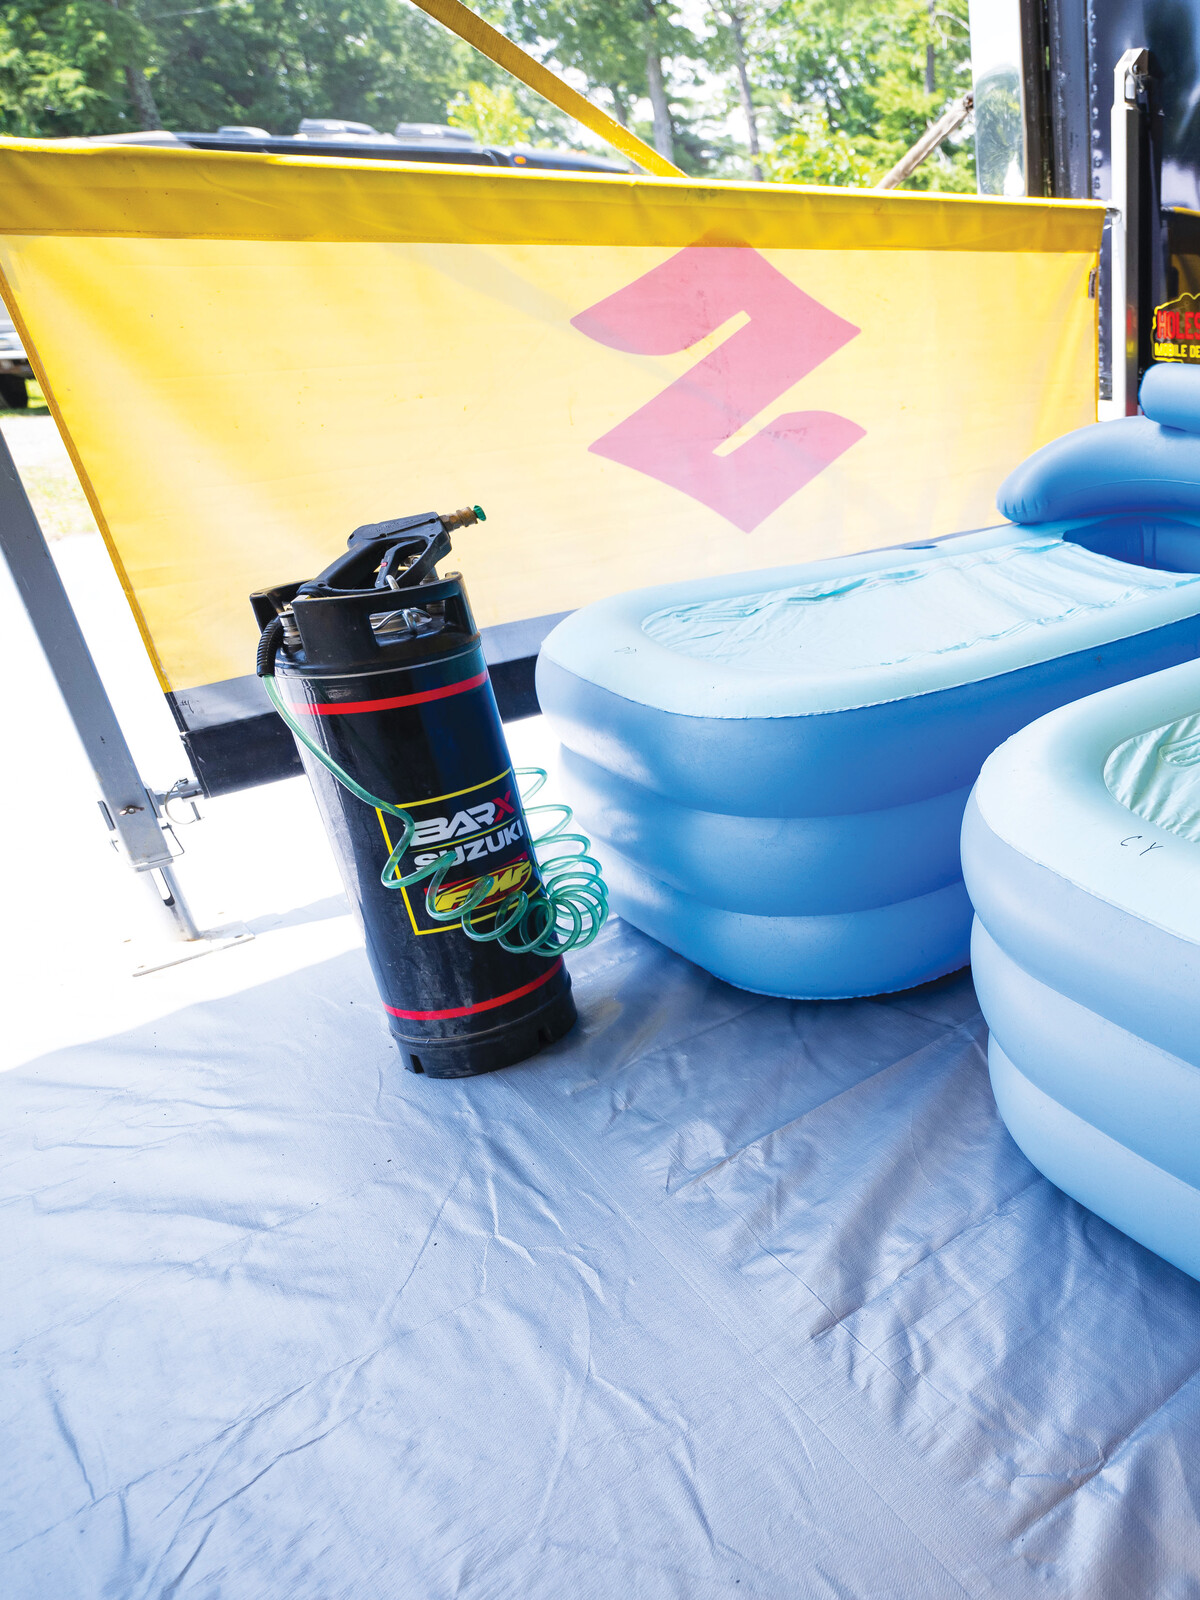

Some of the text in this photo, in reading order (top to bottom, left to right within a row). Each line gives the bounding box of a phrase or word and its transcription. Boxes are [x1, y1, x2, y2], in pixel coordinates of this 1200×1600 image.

[1155, 342, 1187, 358] MOBILE
[410, 790, 515, 847] BARX
[414, 819, 524, 872] SUZUKI
